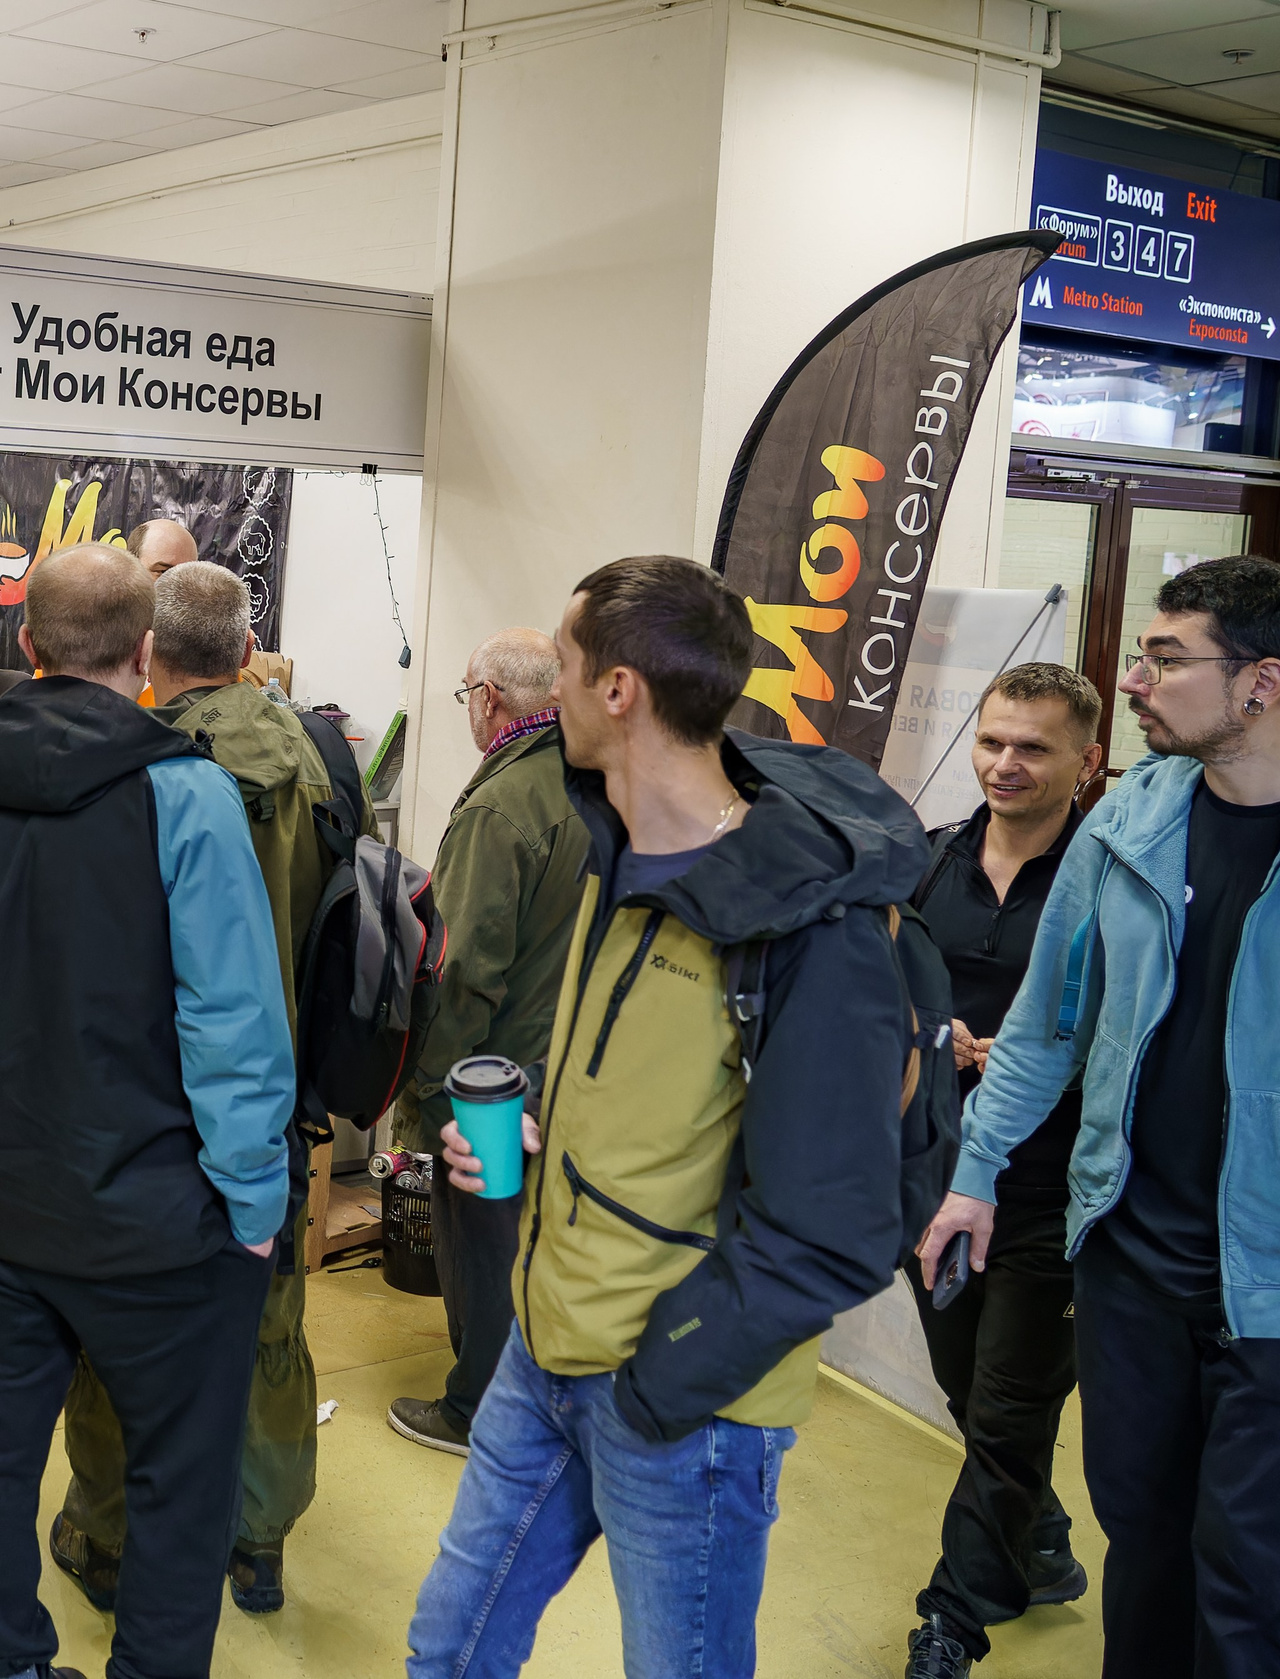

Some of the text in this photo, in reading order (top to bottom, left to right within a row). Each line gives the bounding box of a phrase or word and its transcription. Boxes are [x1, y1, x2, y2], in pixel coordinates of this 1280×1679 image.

[1105, 173, 1218, 223] Выход Exit
[1056, 241, 1087, 259] orum
[1111, 230, 1125, 262] 3
[1141, 236, 1156, 267] 4
[1173, 242, 1188, 272] 7
[1063, 285, 1099, 310] Metro
[1101, 292, 1144, 316] Station
[1178, 295, 1262, 324] «Экспоконста»
[10, 302, 276, 372] Удобная еда
[1189, 318, 1249, 344] Expoconsta
[15, 357, 105, 405] Мои
[118, 366, 322, 425] Консервы
